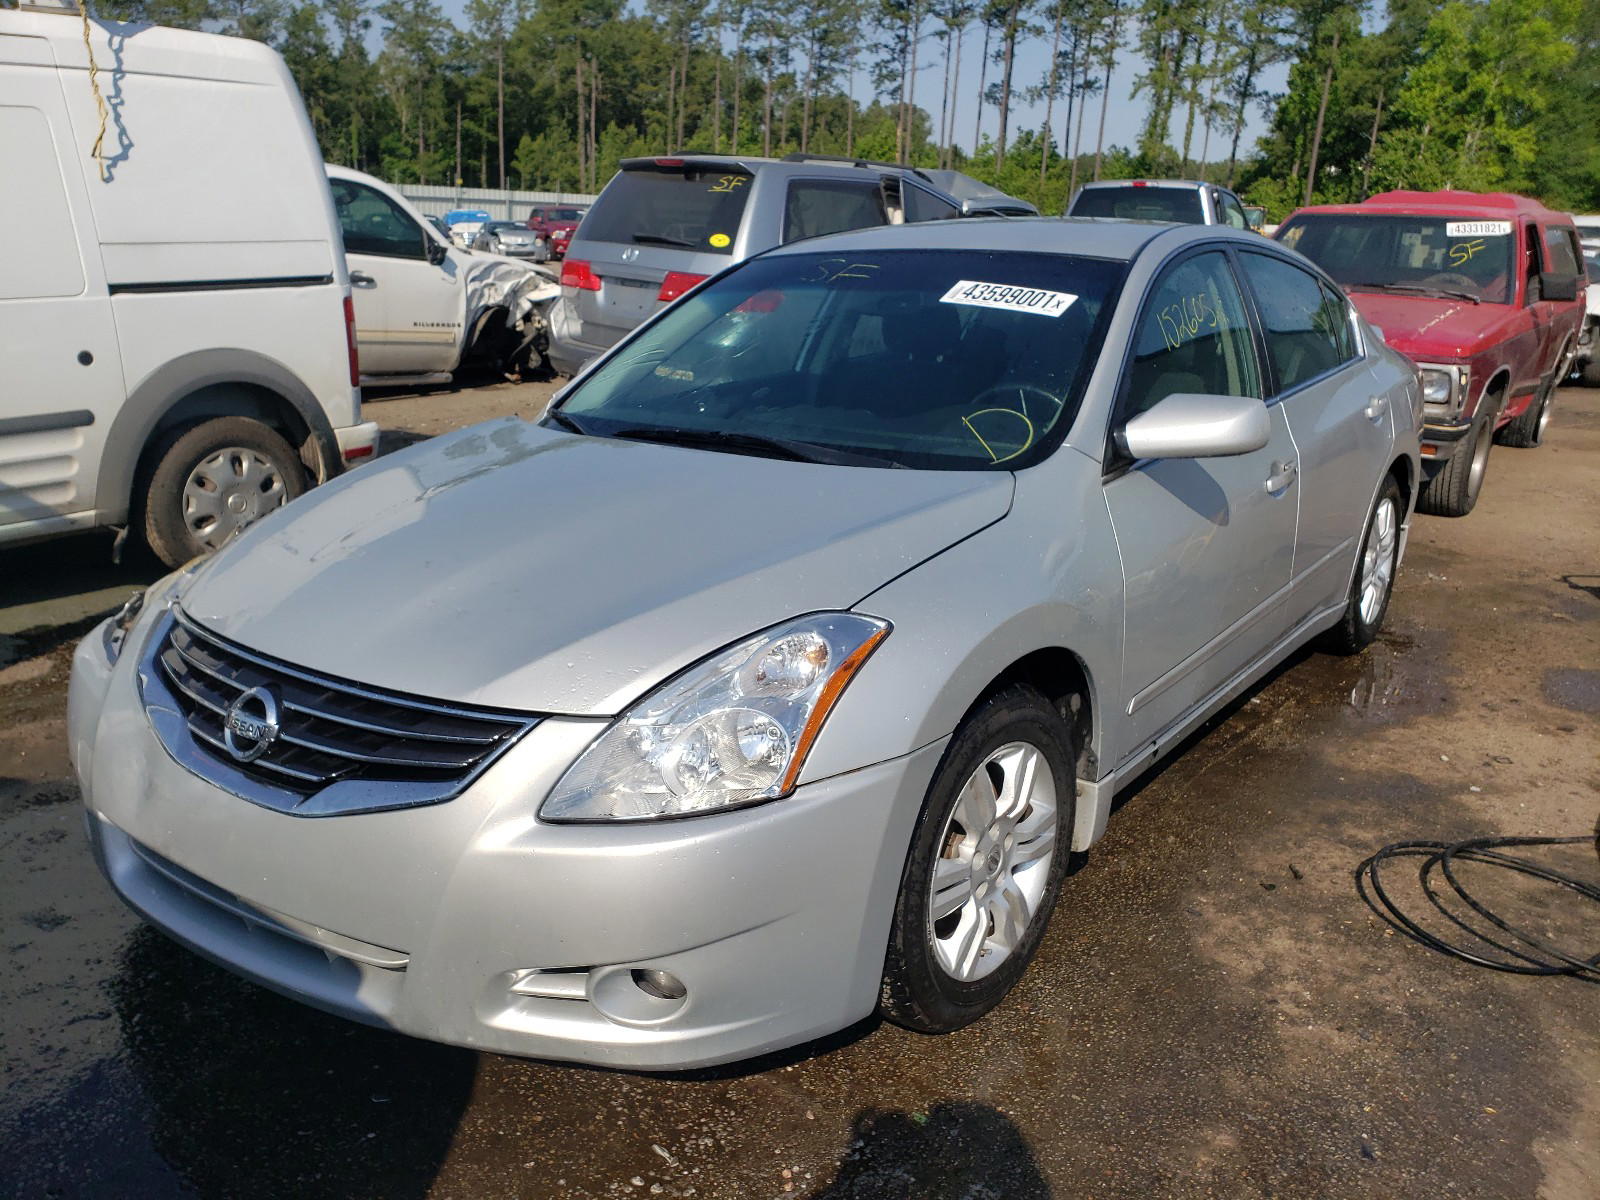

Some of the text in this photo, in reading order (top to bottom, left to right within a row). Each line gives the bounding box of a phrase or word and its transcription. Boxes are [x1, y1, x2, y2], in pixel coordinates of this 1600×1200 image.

[711, 175, 747, 191] SF
[1455, 223, 1501, 233] 43331821
[962, 284, 1057, 309] 43599001
